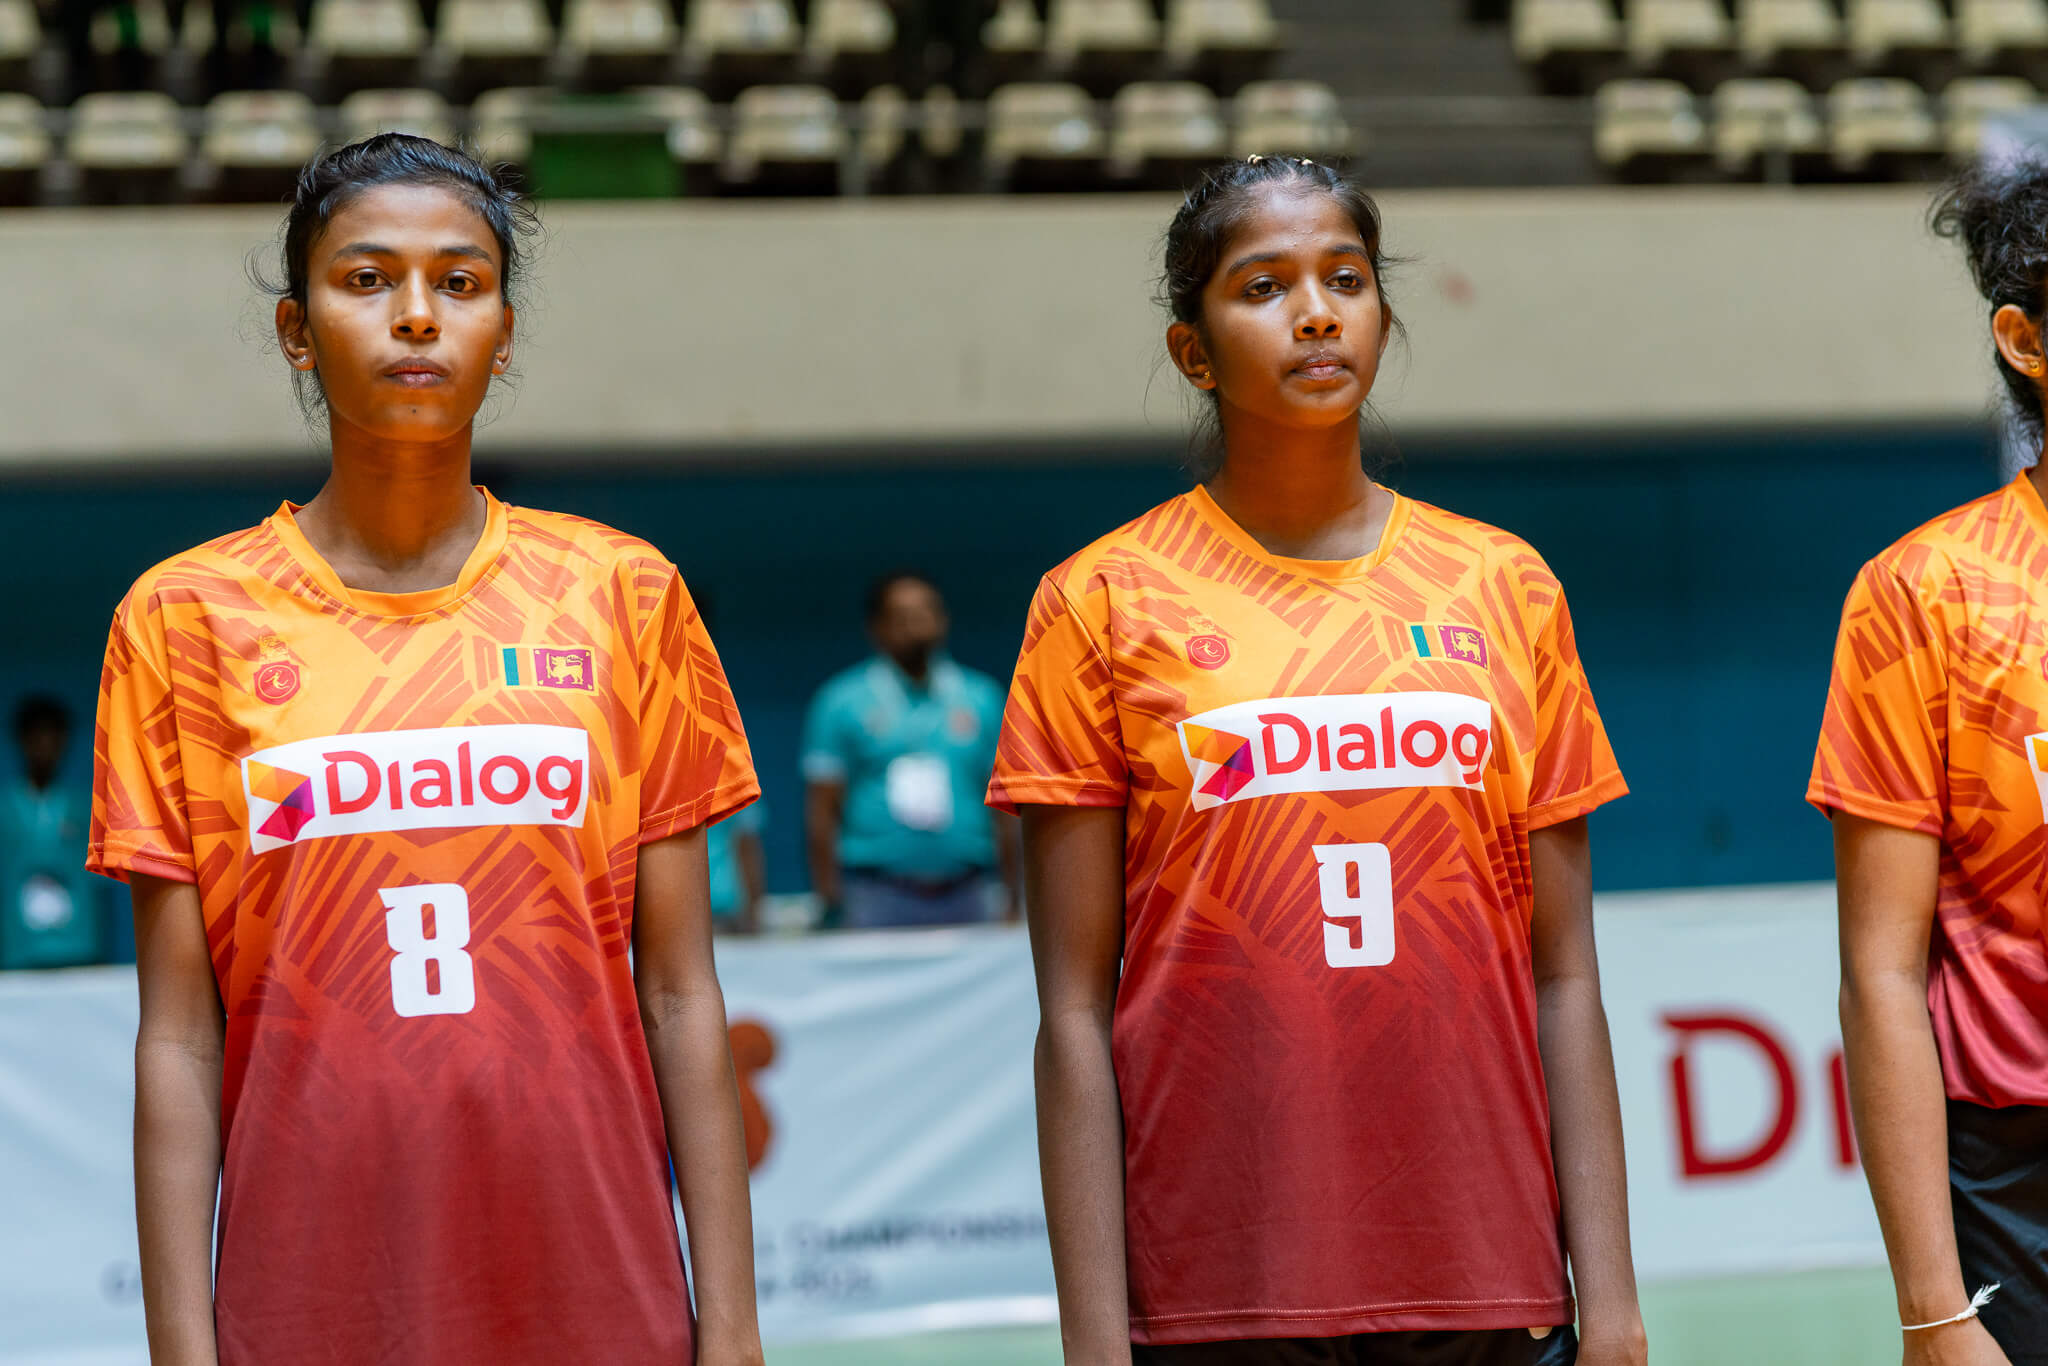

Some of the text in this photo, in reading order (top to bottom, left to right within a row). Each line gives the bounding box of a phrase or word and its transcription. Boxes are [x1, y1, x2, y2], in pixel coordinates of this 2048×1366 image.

[322, 740, 583, 820] Dialog
[1257, 706, 1489, 785] Dialog
[381, 883, 476, 1018] 8
[1312, 842, 1396, 969] 9
